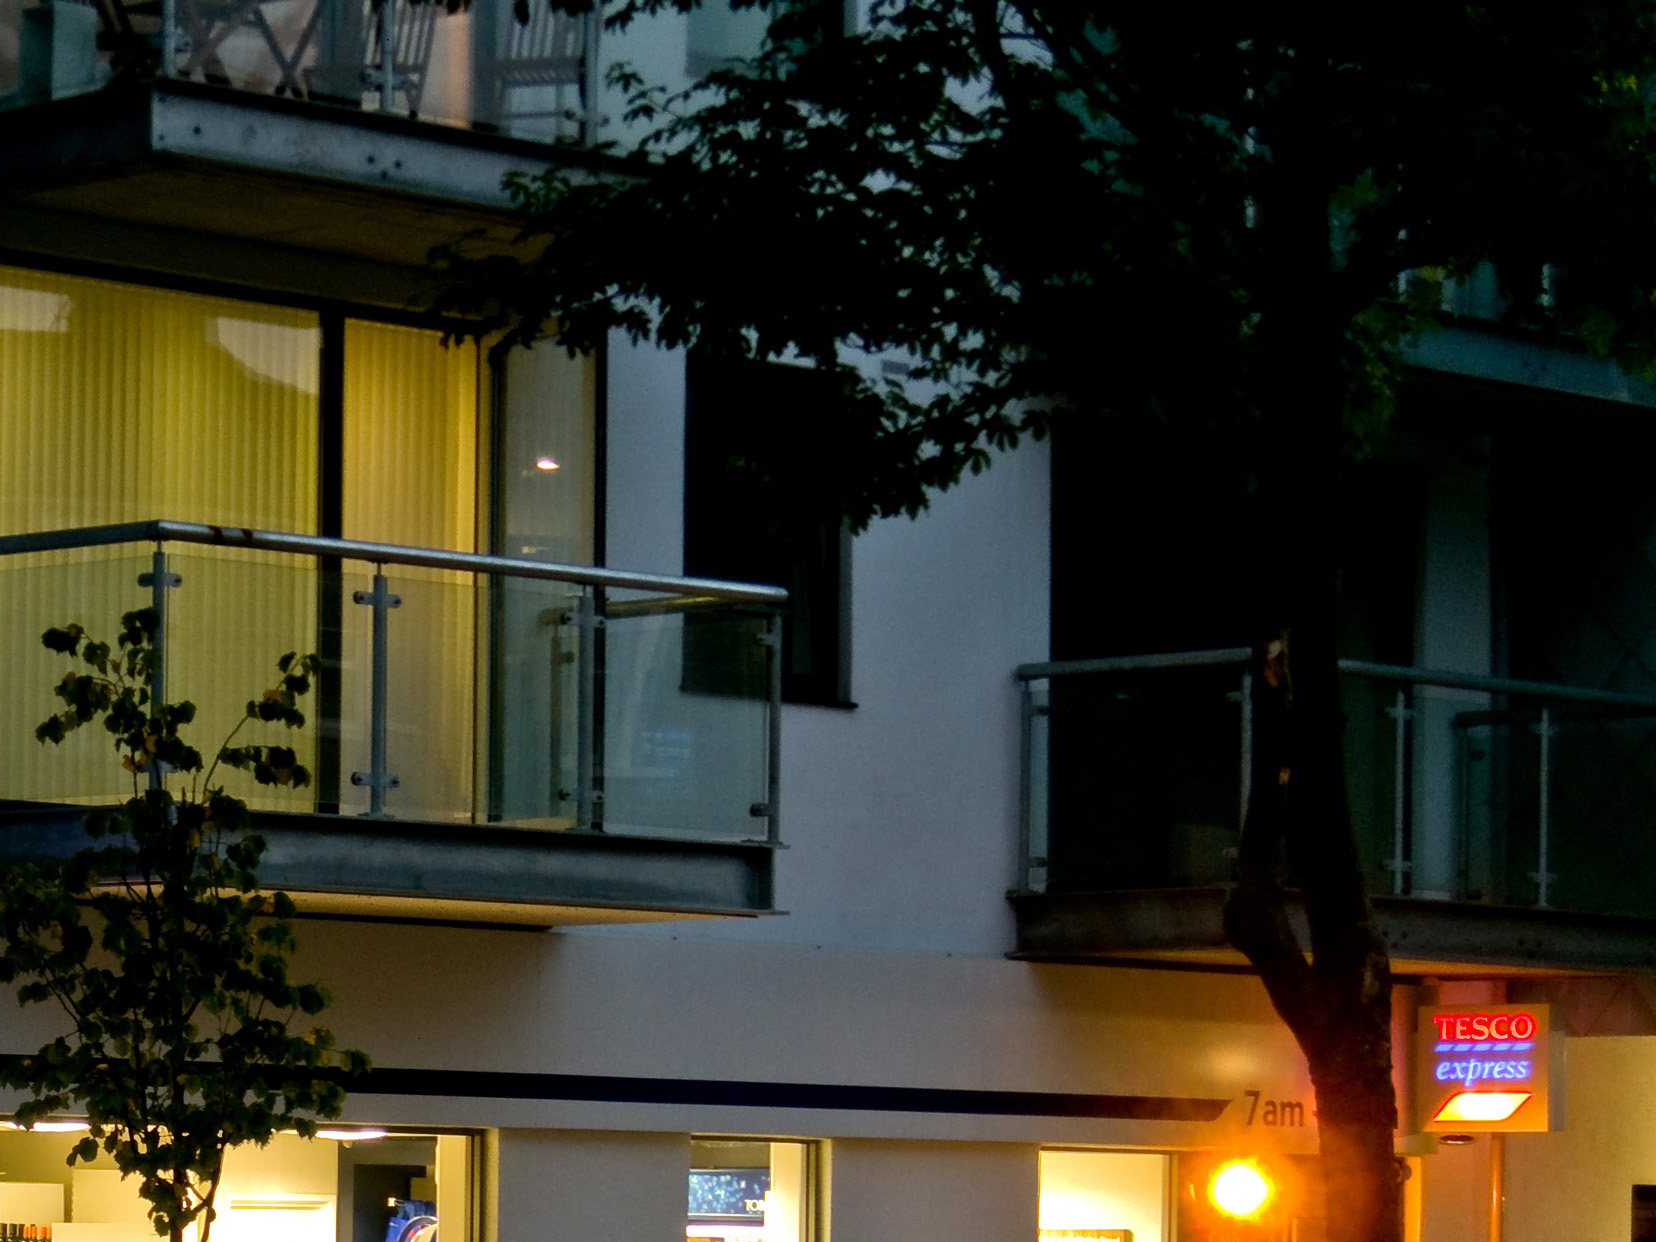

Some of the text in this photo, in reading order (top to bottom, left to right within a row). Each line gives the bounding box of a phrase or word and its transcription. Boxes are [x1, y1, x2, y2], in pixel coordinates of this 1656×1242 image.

[1432, 1013, 1535, 1041] TESCO
[1434, 1058, 1531, 1087] express
[1244, 1089, 1305, 1128] 7am
